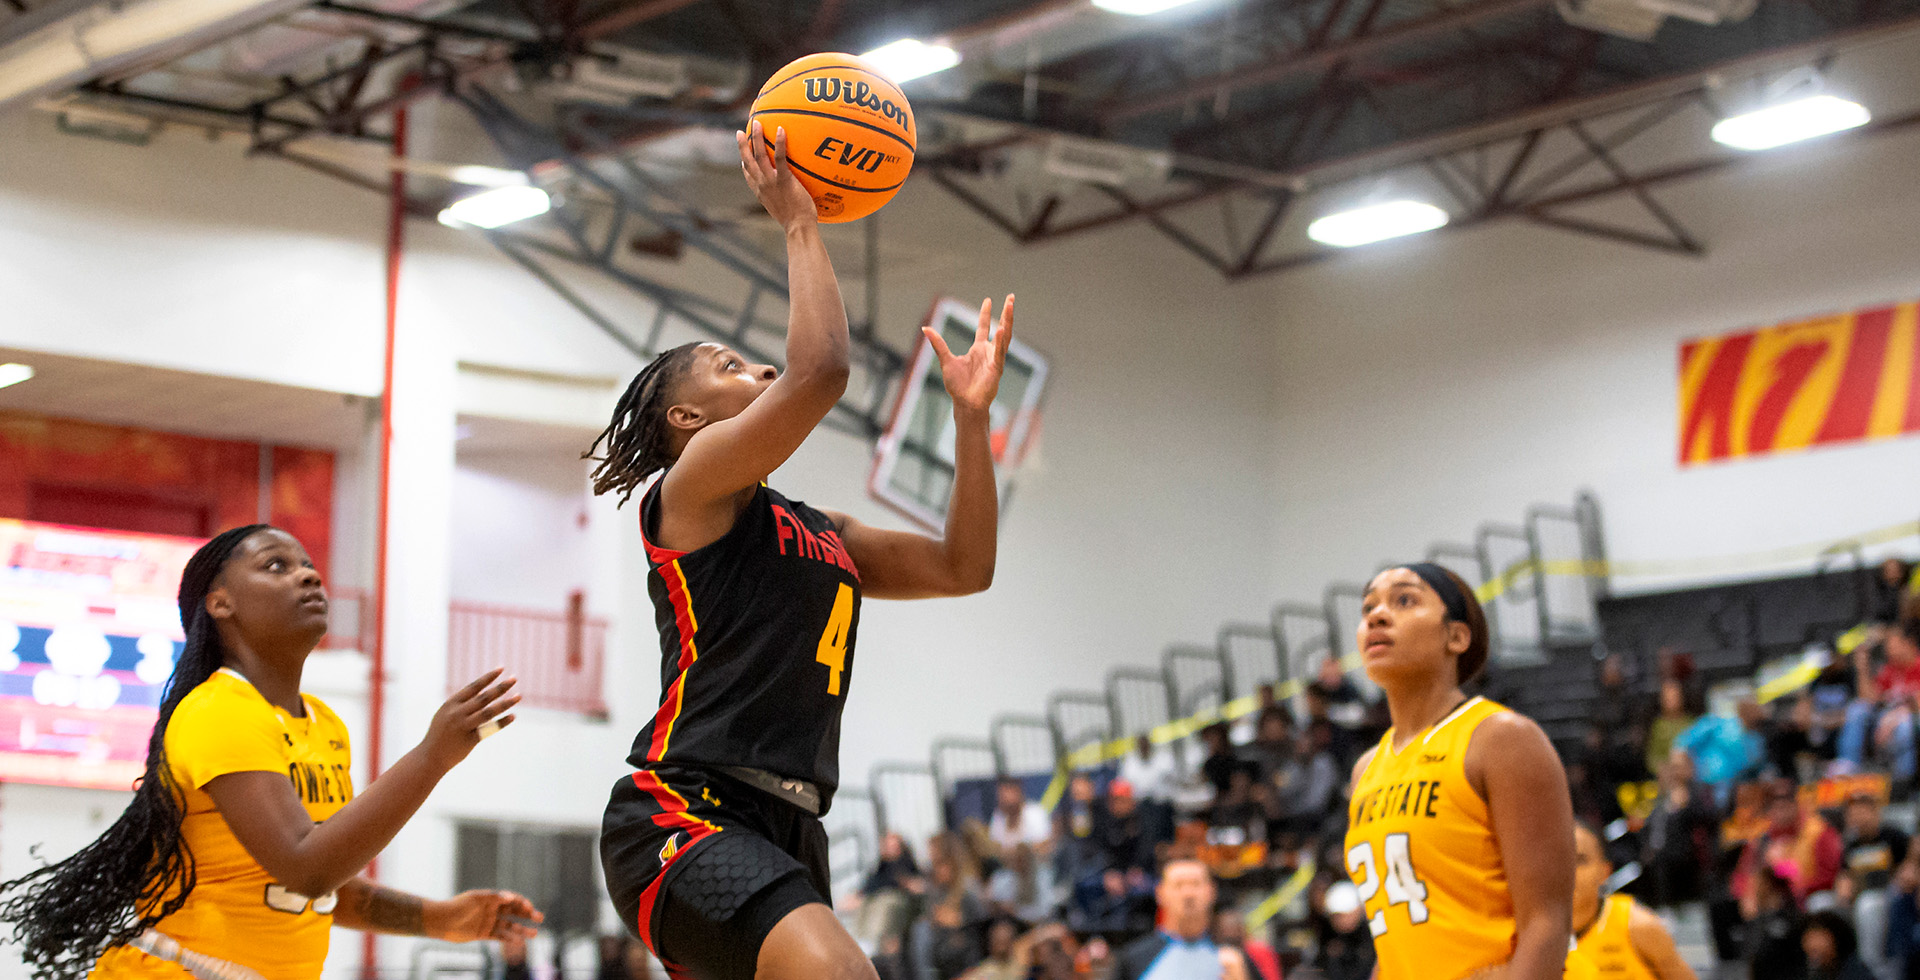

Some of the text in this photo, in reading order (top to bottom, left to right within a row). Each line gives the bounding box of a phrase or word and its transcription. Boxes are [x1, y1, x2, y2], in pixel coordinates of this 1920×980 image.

[803, 78, 909, 132] Wilson
[814, 137, 885, 173] EVO
[815, 582, 854, 696] 4
[1380, 780, 1441, 819] STATE
[1347, 832, 1430, 939] 24
